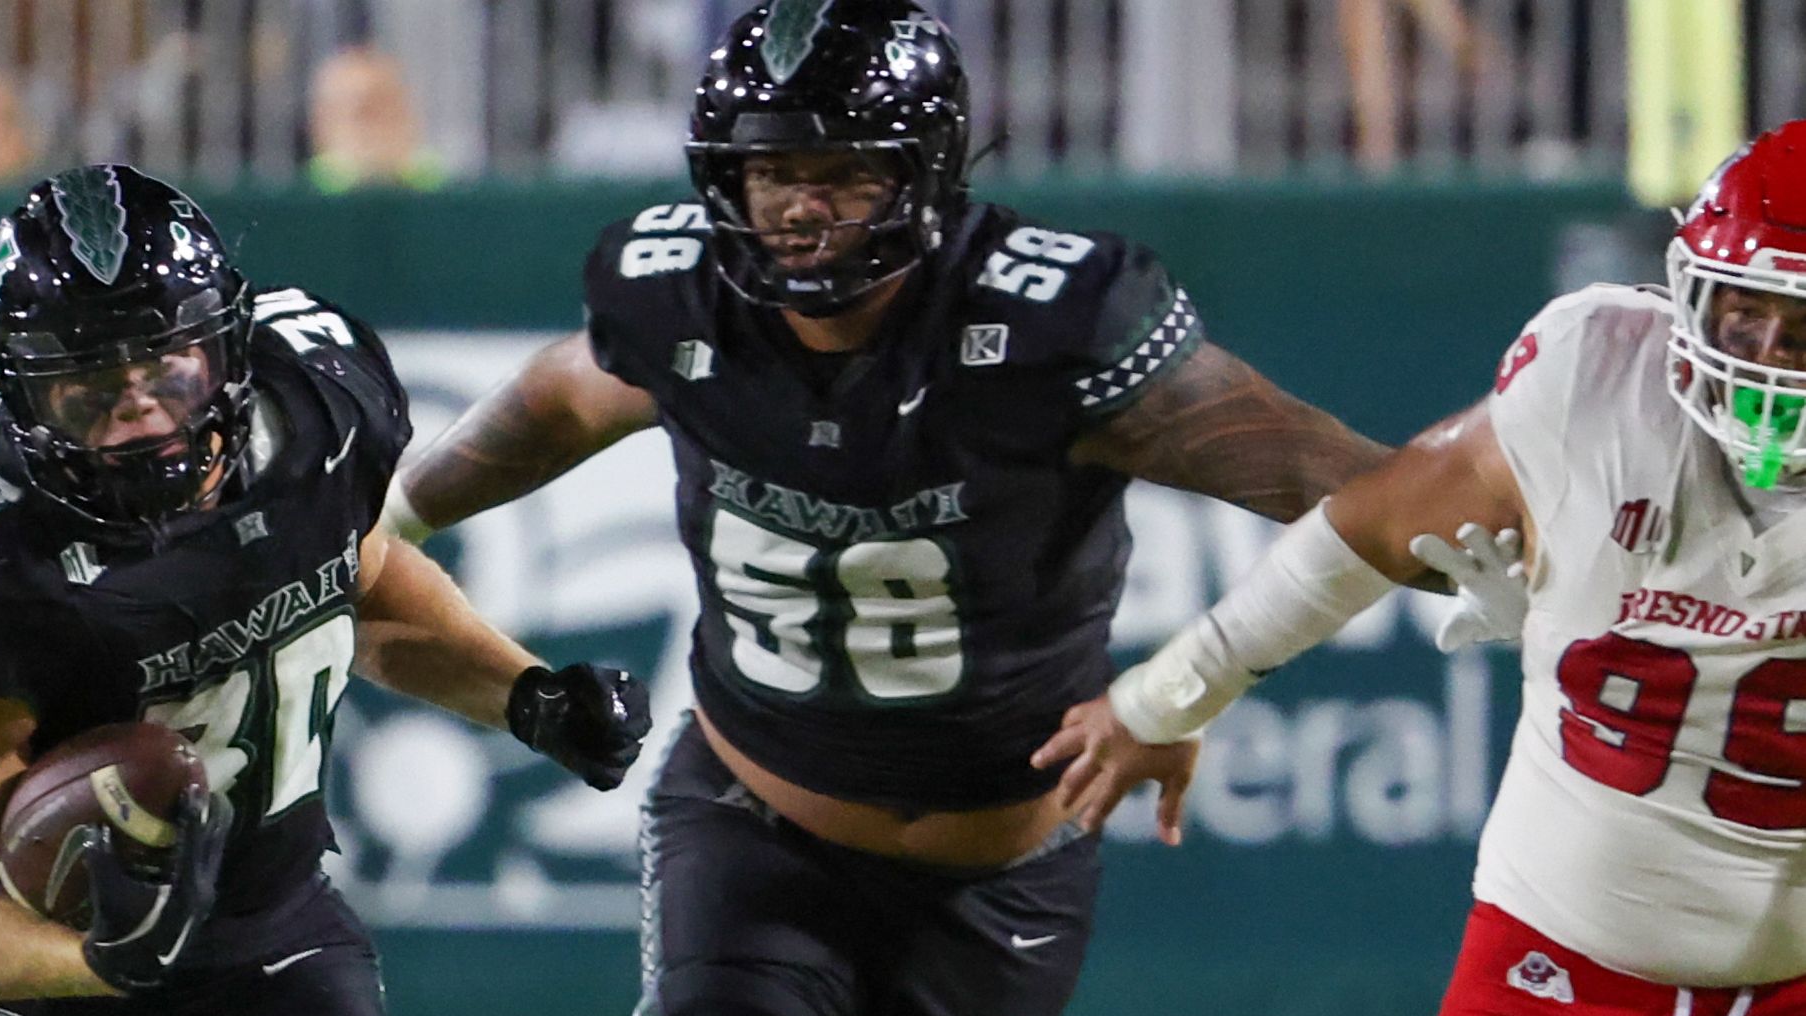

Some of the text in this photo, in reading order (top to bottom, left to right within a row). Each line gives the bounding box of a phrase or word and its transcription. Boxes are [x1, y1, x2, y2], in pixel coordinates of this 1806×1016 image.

[976, 226, 1095, 301] 58
[709, 507, 965, 699] 58
[143, 612, 356, 818] 30
